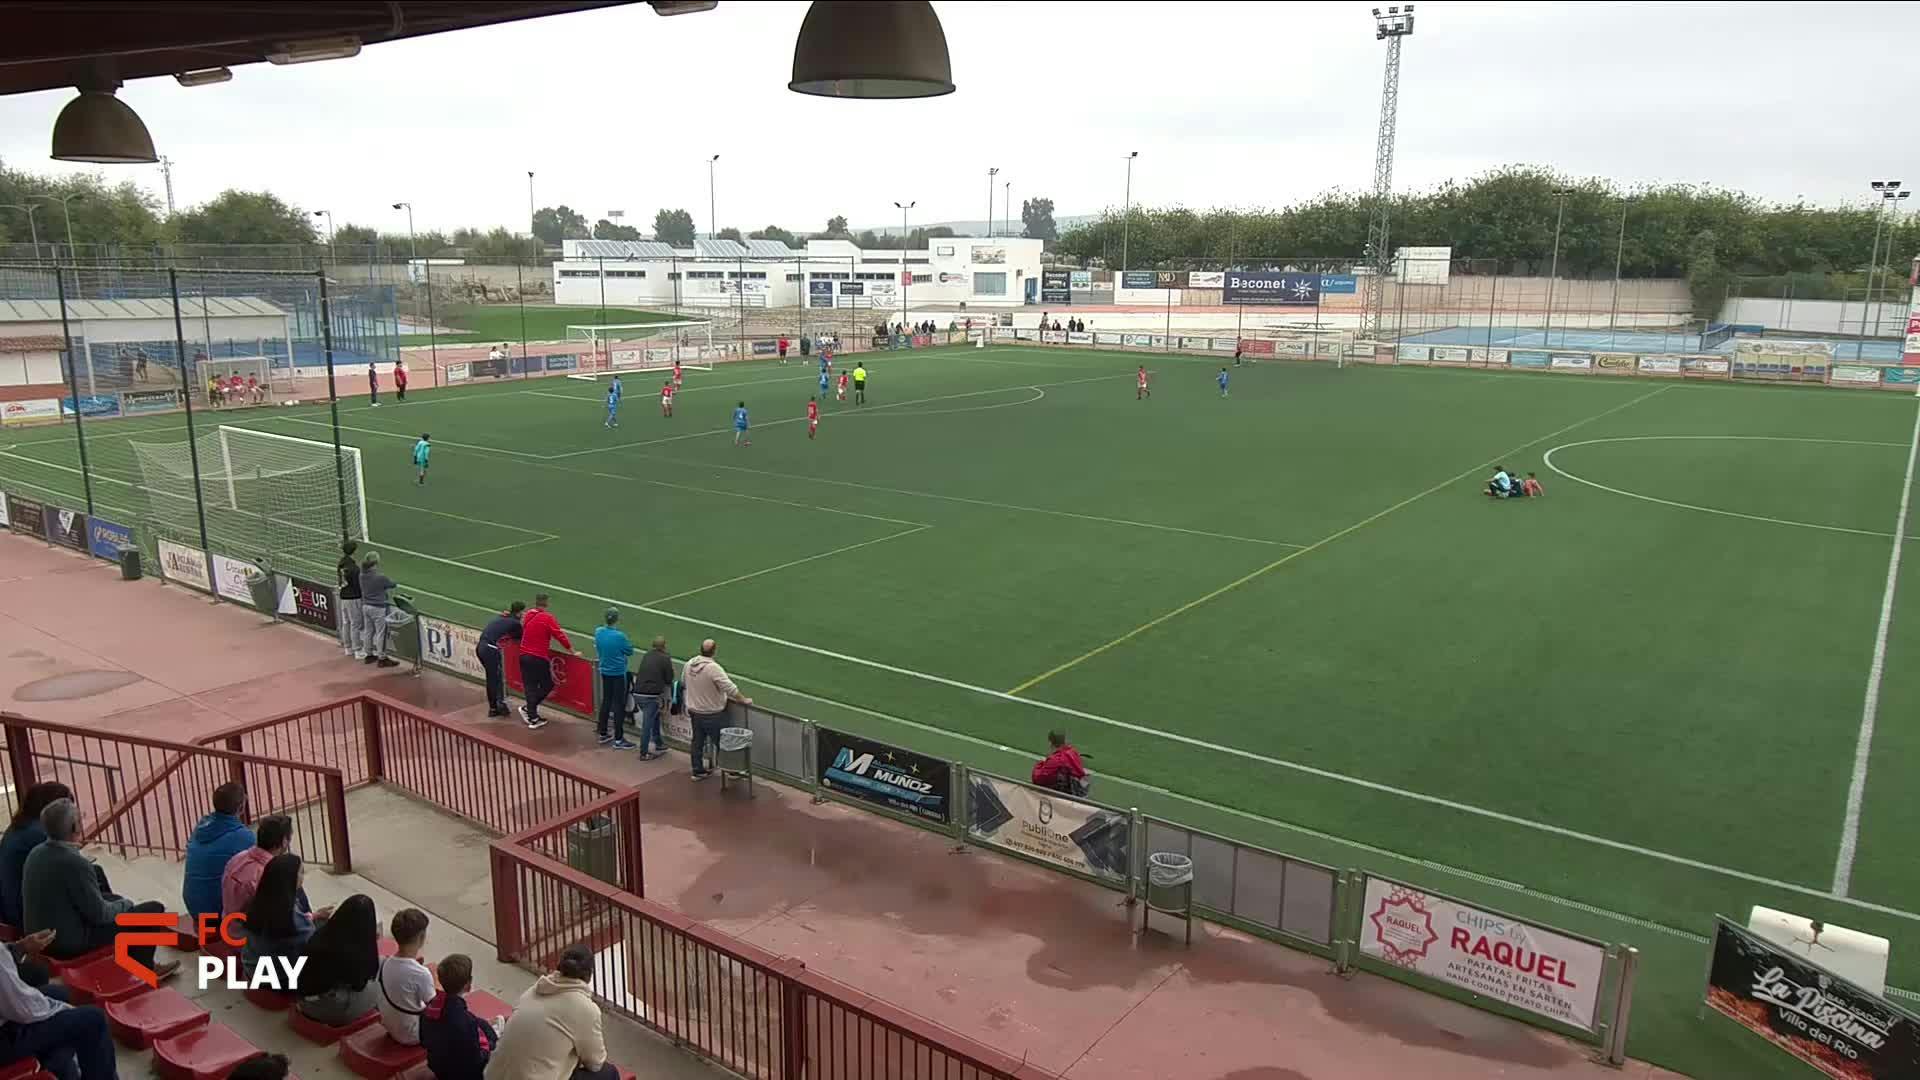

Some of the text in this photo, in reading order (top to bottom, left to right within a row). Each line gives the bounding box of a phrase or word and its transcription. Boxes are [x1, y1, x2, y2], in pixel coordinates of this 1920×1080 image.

[874, 769, 933, 794] MUÑOZ
[1386, 915, 1421, 934] RAQUEL
[1456, 910, 1526, 945] CHIPS by
[1451, 926, 1577, 988] RAQUEL
[1447, 962, 1509, 988] ARTESANAS
[1512, 984, 1527, 995] EN
[1467, 958, 1553, 993] PATATAS FRITAS
[1507, 992, 1543, 1009] POTATO
[1752, 966, 1886, 1049] La Piscina
[1778, 1007, 1808, 1031] Villa
[1809, 1026, 1833, 1044] del
